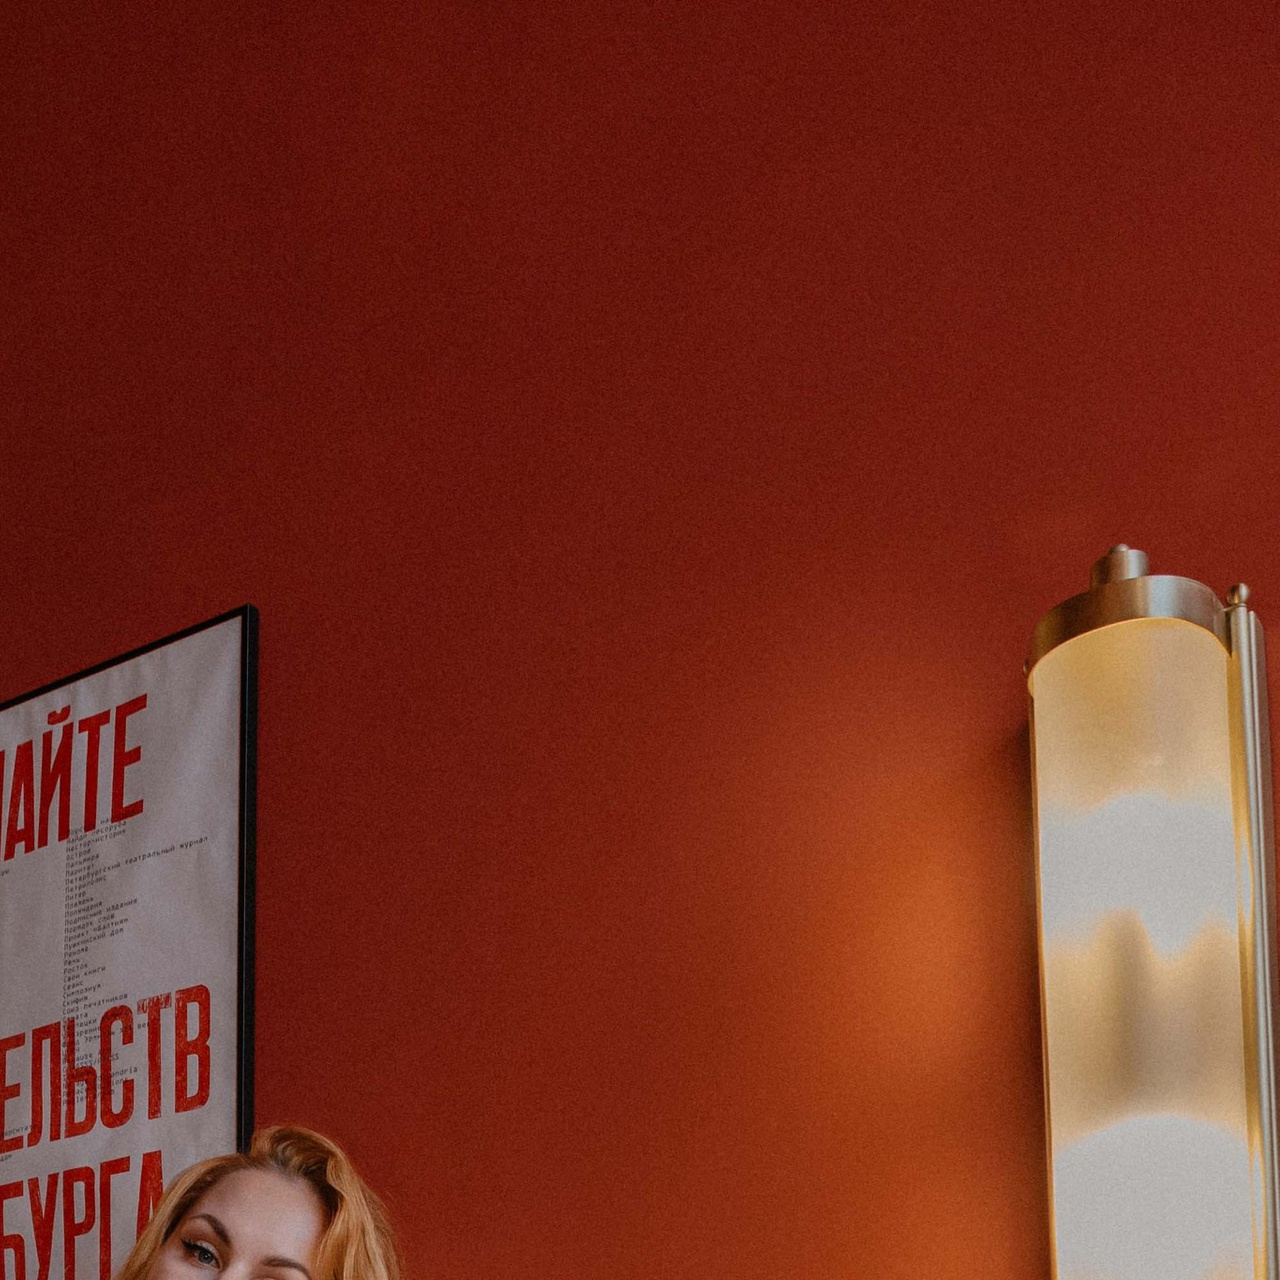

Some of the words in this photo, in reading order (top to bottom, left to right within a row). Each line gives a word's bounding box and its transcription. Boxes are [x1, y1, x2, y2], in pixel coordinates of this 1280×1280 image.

[65, 862, 121, 886] Петербургский
[125, 845, 176, 865] театральный
[180, 836, 209, 851] журнал
[65, 863, 95, 877] Паритет
[65, 874, 107, 894] Петрополис
[64, 890, 87, 903] Питер
[64, 910, 102, 927] Подписные
[106, 898, 138, 913] издания
[63, 963, 88, 975] Росток
[83, 993, 129, 1010] печатников
